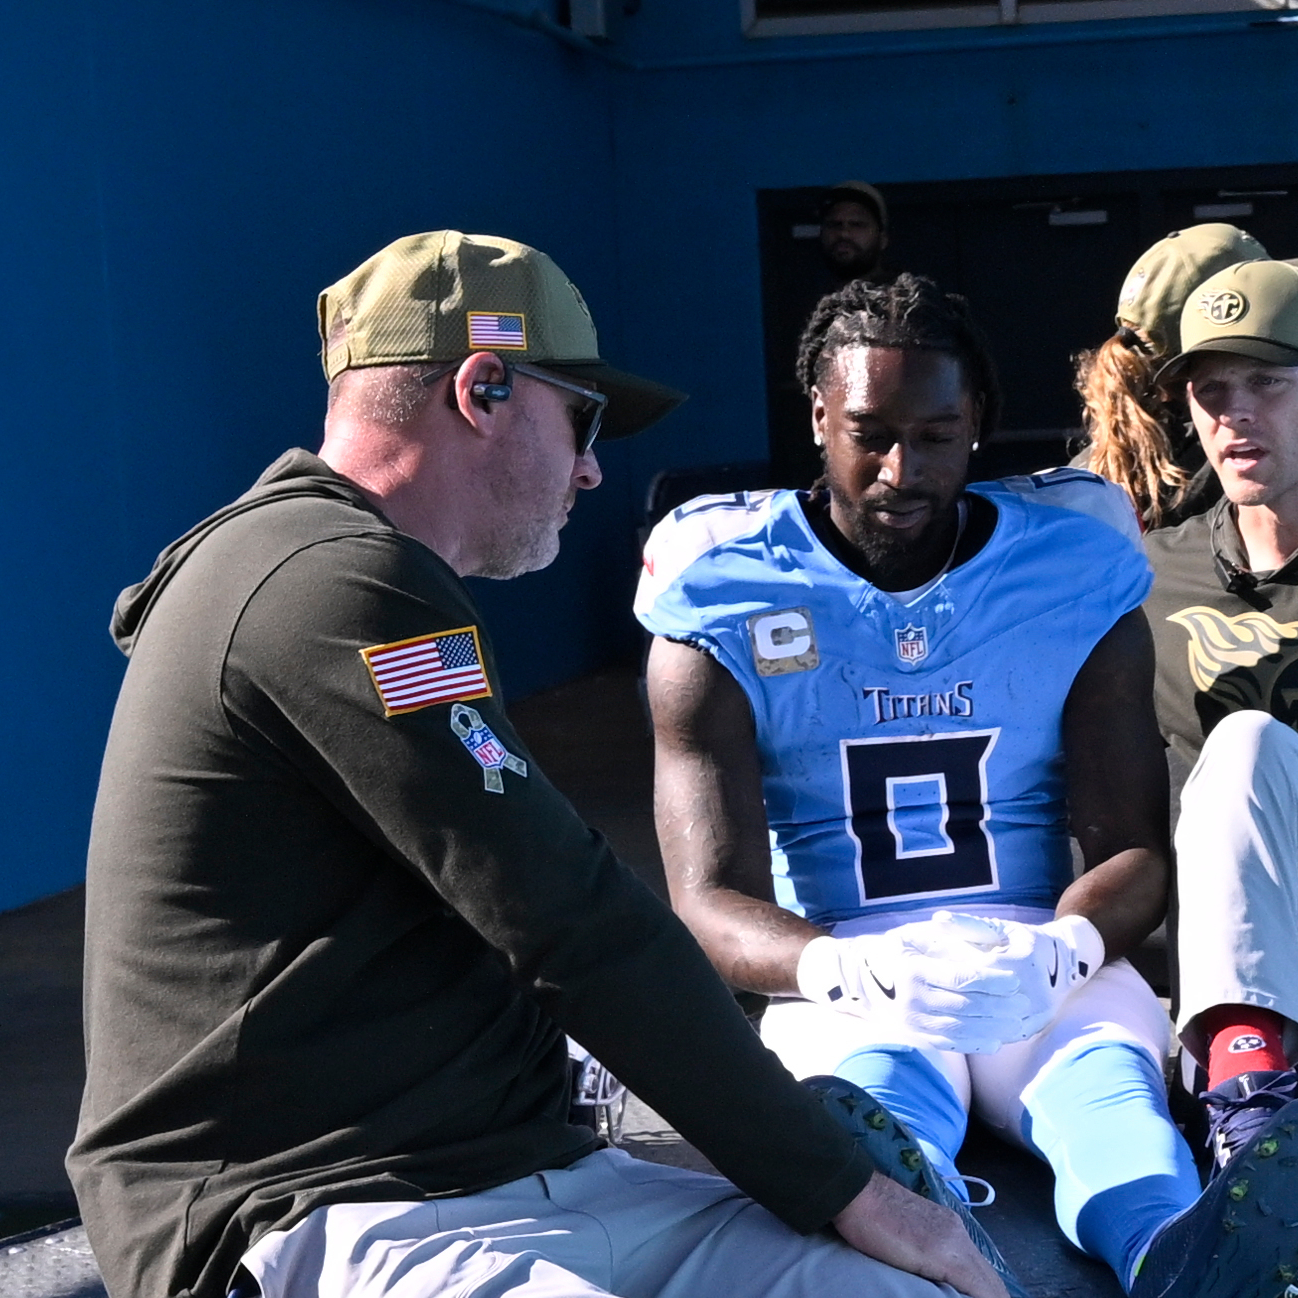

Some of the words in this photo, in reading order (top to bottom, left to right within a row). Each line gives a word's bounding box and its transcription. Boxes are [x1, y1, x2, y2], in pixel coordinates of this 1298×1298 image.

[754, 612, 810, 660] C
[901, 641, 924, 657] NFL
[862, 680, 973, 726] TITANS
[475, 741, 504, 765] NFL
[839, 727, 1002, 907] 0
